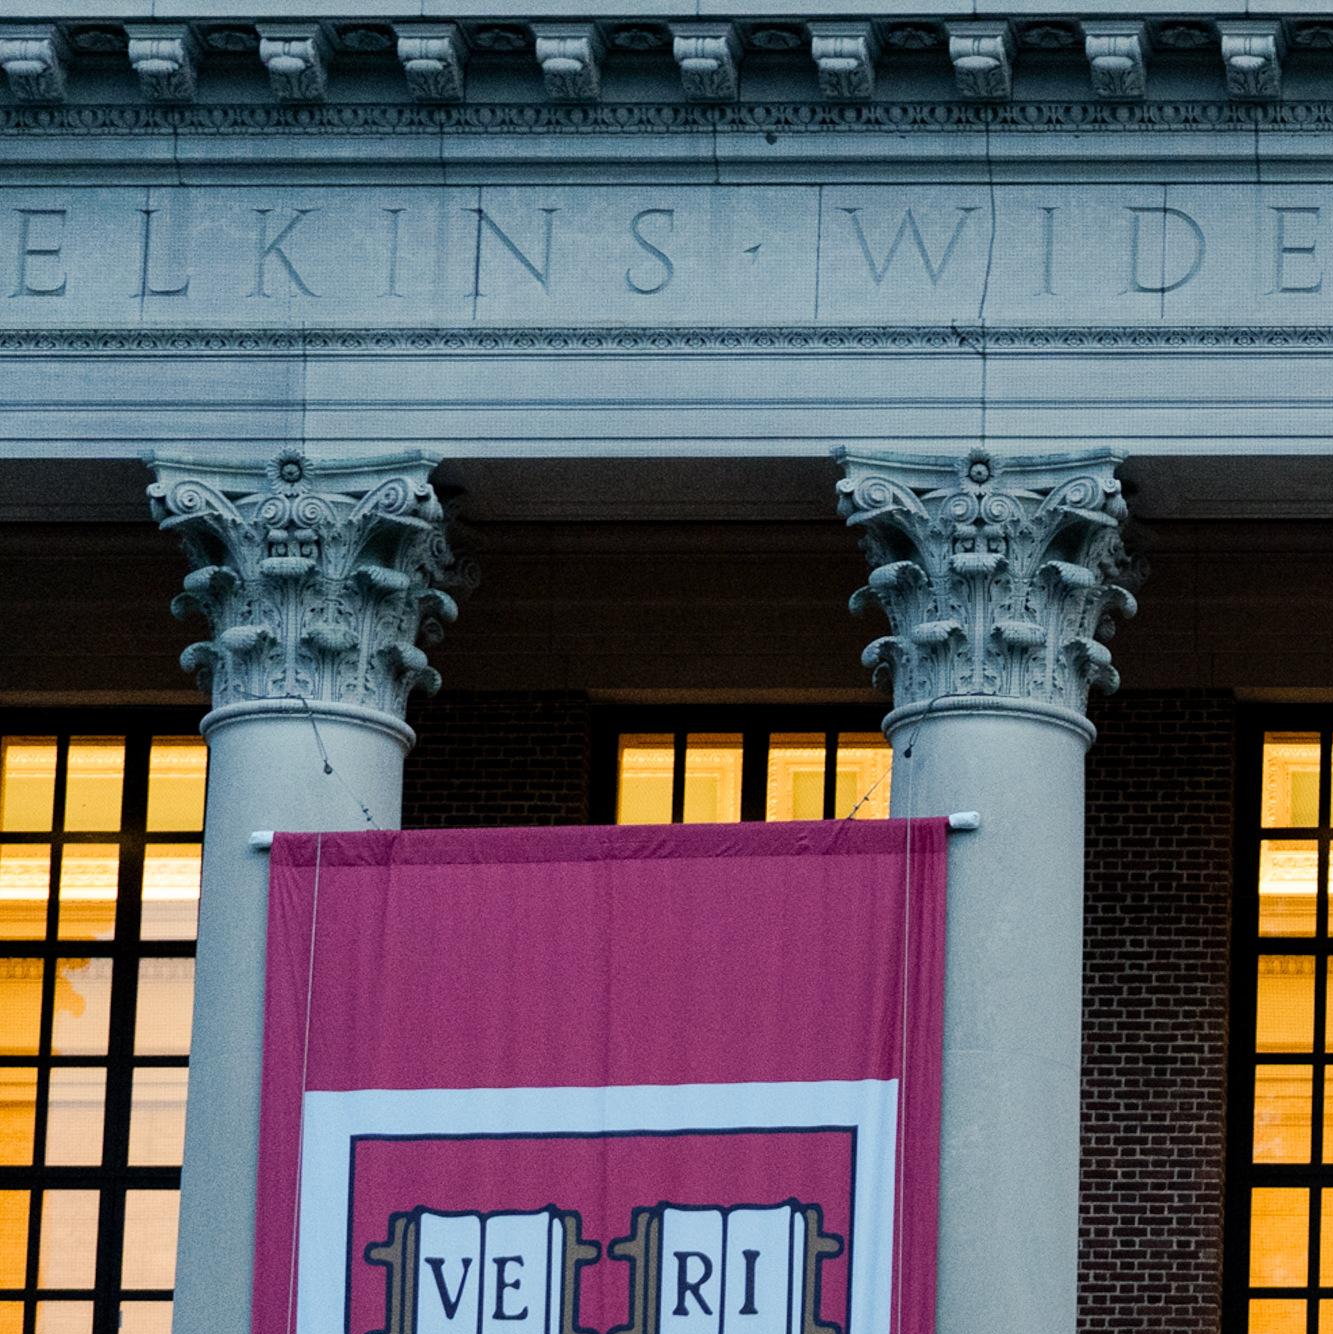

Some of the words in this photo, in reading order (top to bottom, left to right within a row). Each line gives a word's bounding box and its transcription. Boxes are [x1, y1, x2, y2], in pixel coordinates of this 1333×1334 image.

[6, 207, 676, 298] ELKINS
[424, 1254, 530, 1321] VE
[671, 1248, 760, 1316] RI
